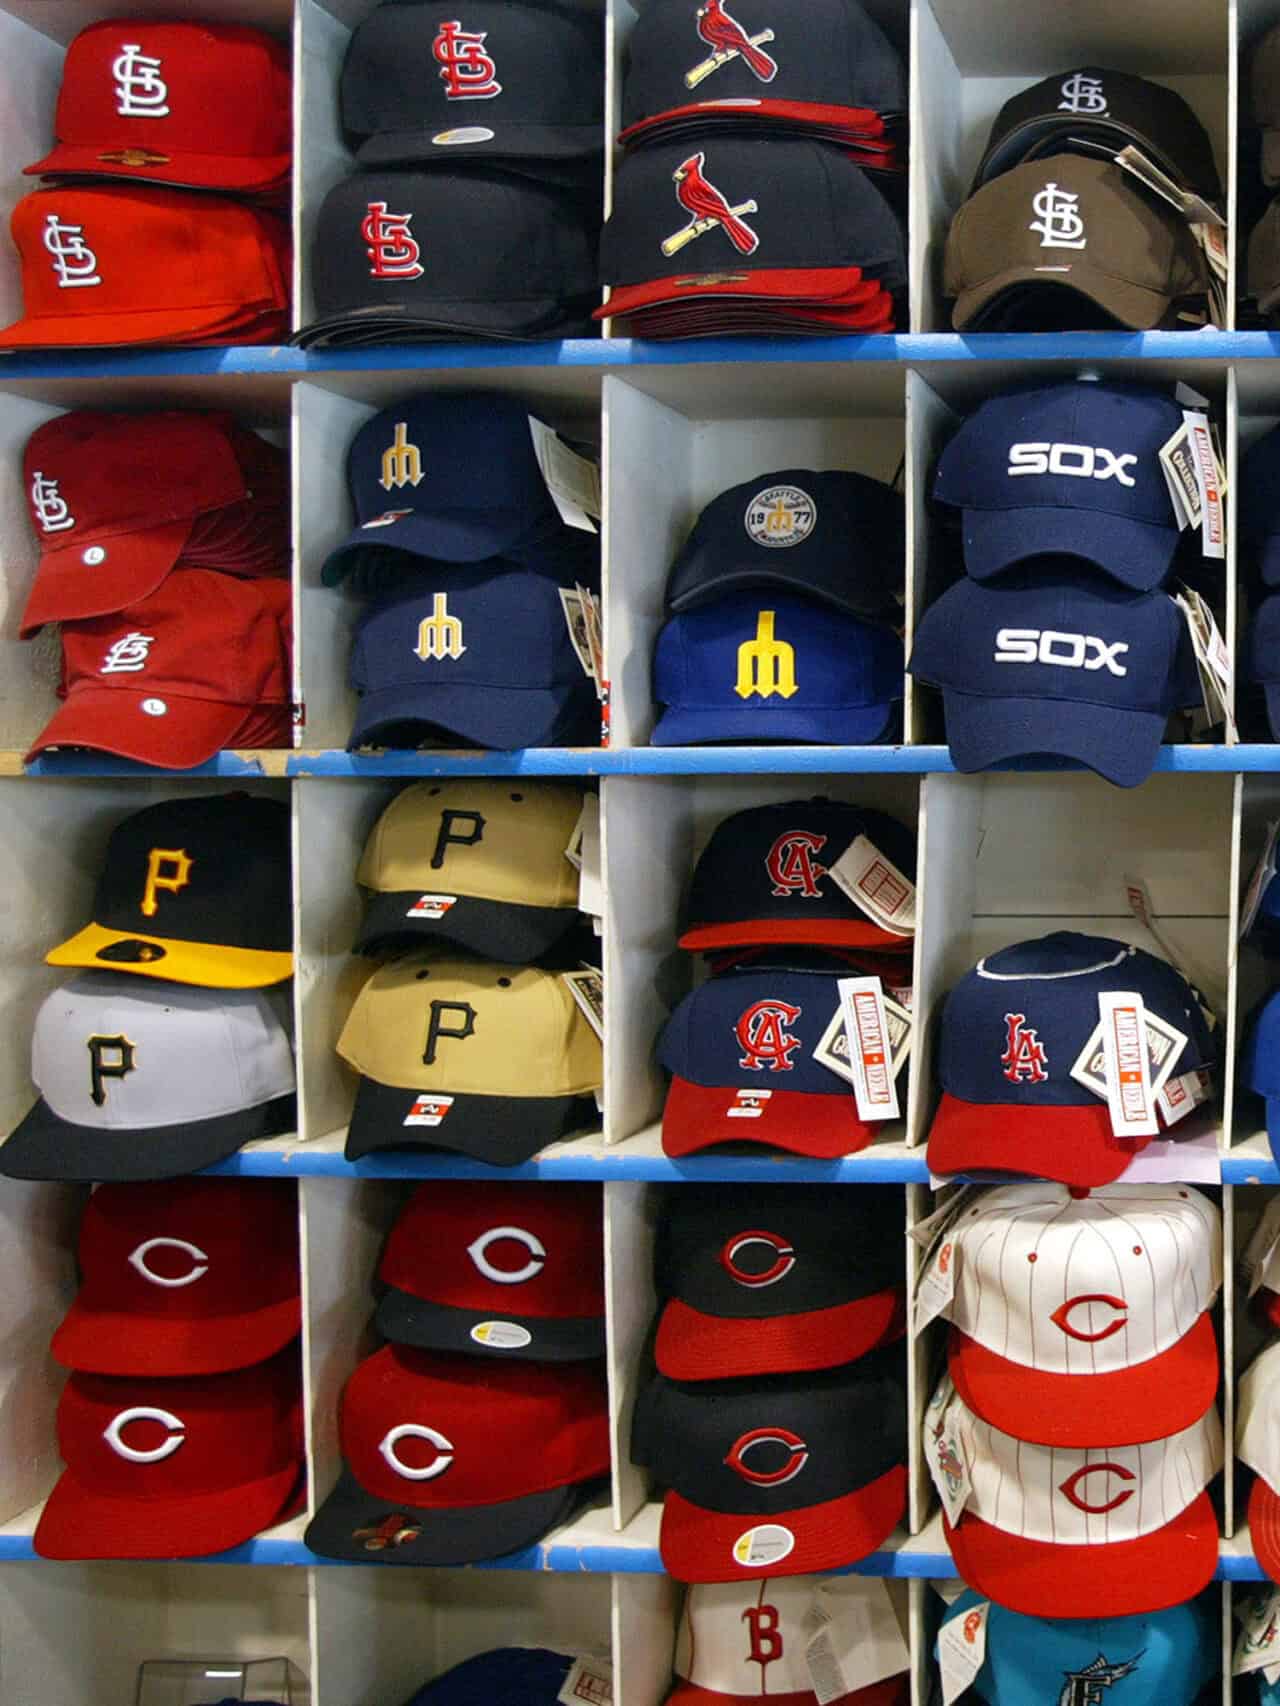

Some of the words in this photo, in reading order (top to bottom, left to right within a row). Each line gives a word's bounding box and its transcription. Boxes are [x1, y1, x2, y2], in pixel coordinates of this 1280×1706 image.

[1007, 441, 1138, 487] SOX
[794, 511, 810, 524] 77
[994, 628, 1129, 677] SOX
[431, 809, 487, 869] P
[141, 848, 192, 917] P
[422, 999, 479, 1066] P
[1001, 1012, 1048, 1084] LA
[87, 1032, 137, 1108] P
[128, 1237, 208, 1287] C
[467, 1226, 546, 1284] C
[718, 1230, 796, 1289] C
[1050, 1294, 1129, 1342] C
[103, 1407, 185, 1463] C
[378, 1424, 454, 1480] C
[725, 1427, 808, 1487] C
[1059, 1462, 1136, 1514] C
[741, 1604, 783, 1666] B
